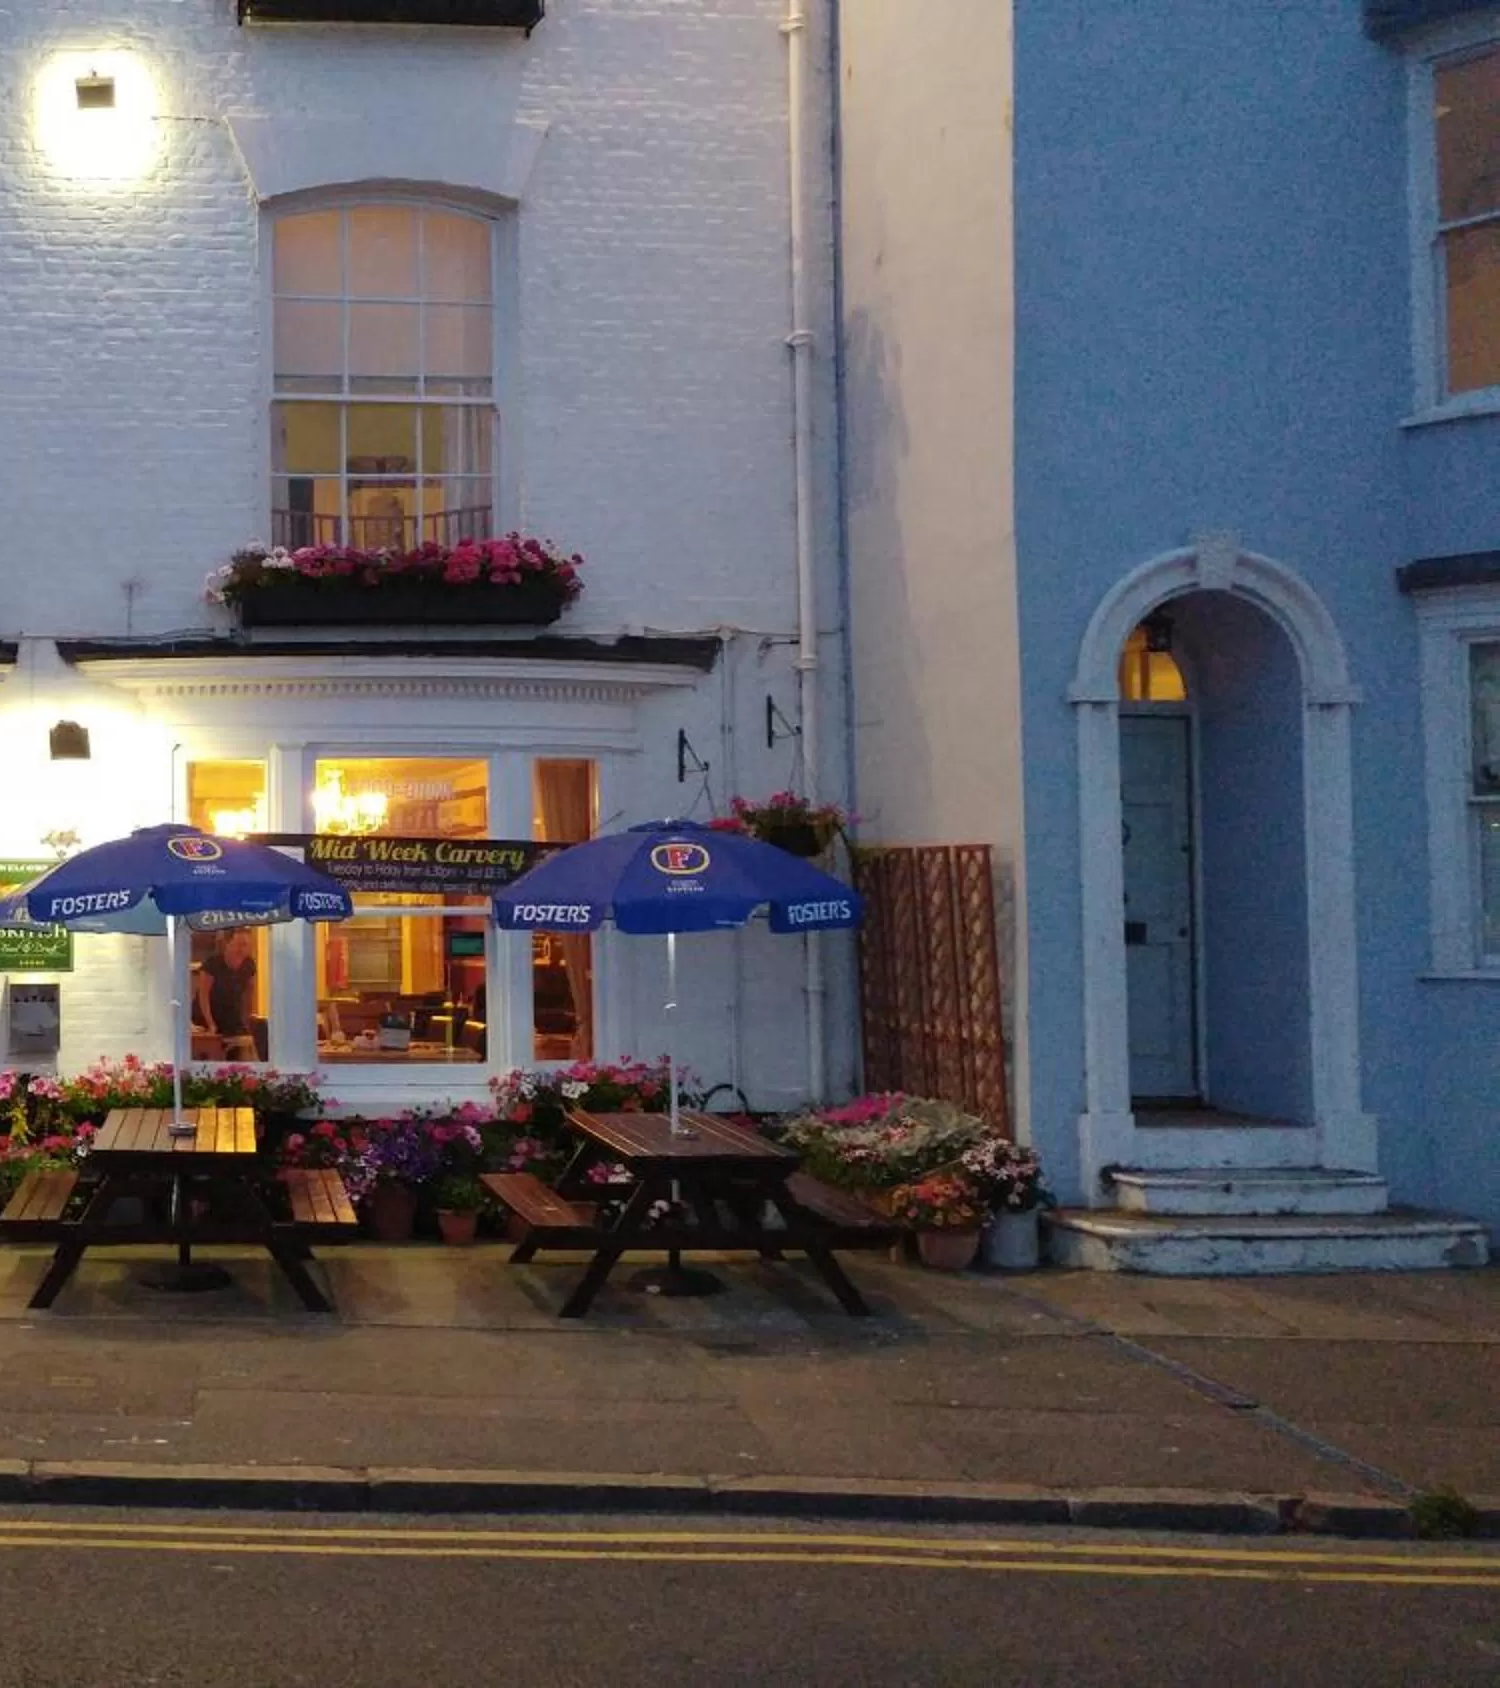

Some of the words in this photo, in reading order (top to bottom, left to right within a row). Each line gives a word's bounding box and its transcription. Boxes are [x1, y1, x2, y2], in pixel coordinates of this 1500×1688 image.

[310, 838, 357, 859] Mid
[363, 840, 428, 862] Week
[435, 841, 525, 872] Carvery
[513, 904, 591, 923] FOSTER'S
